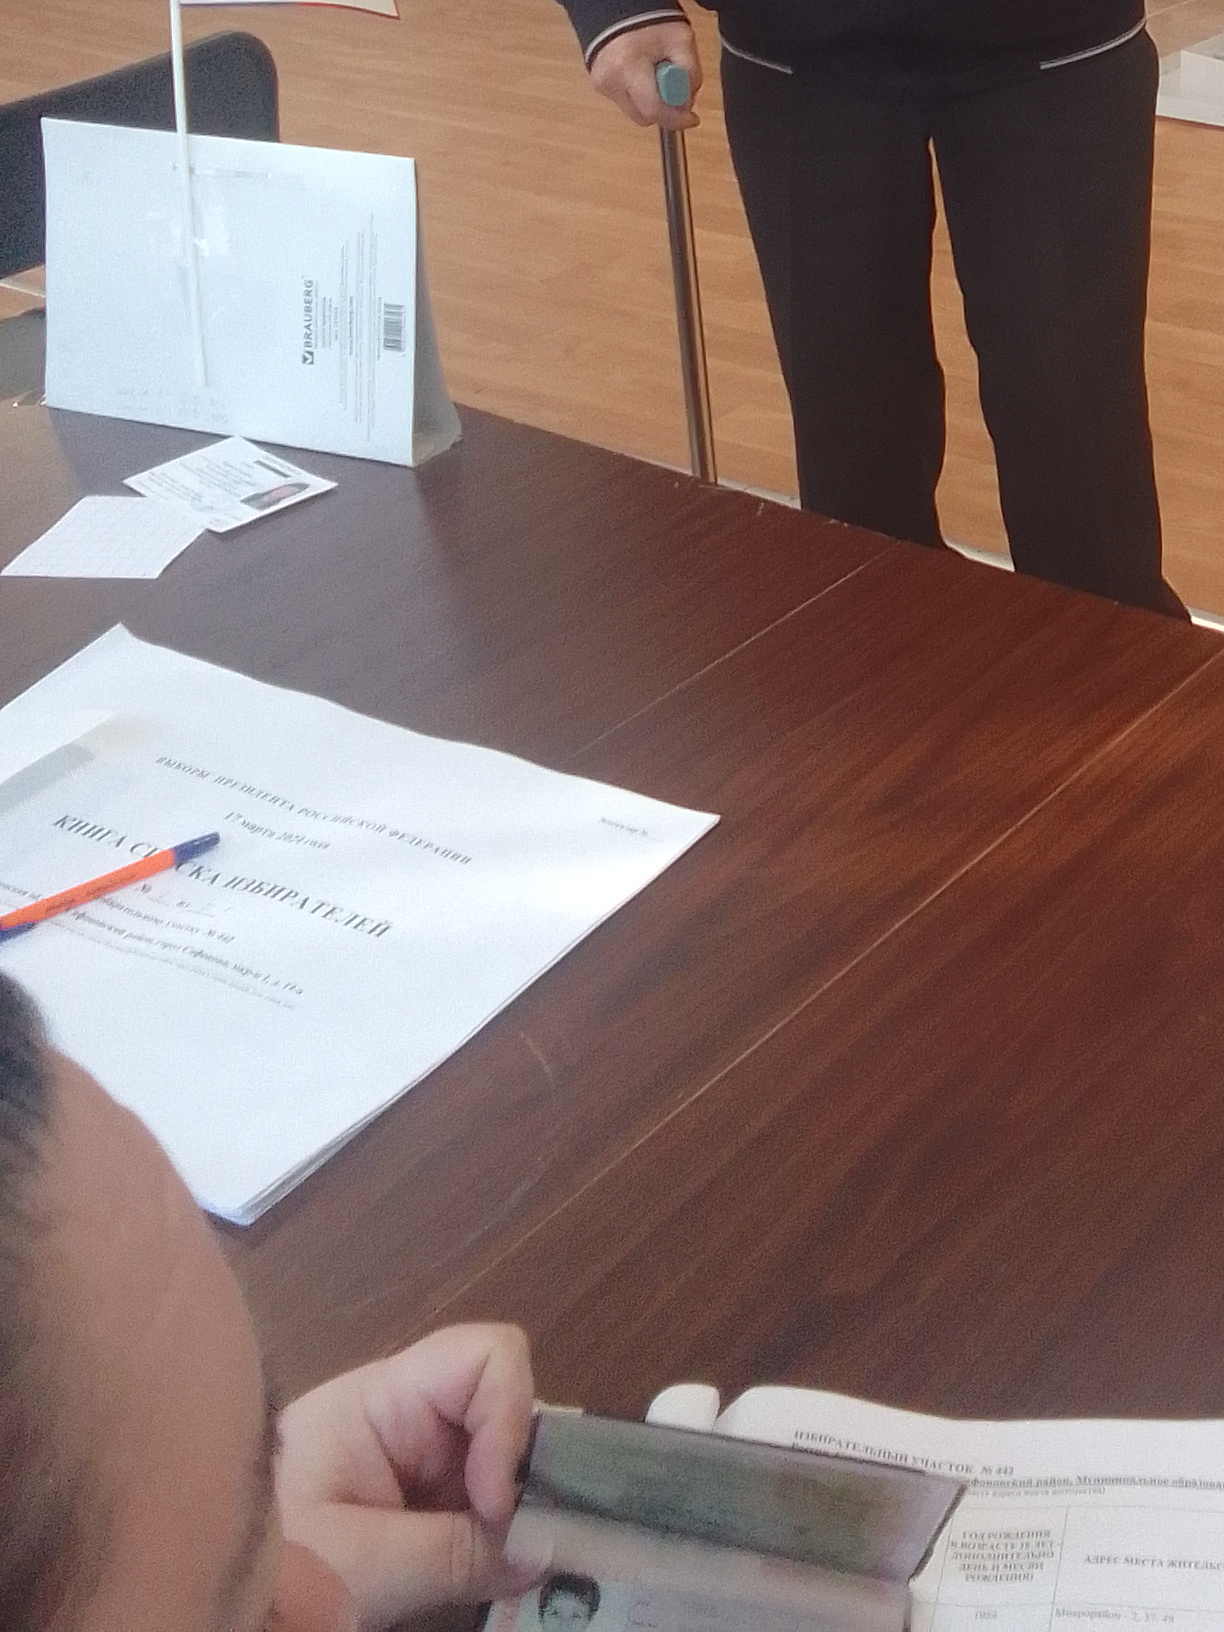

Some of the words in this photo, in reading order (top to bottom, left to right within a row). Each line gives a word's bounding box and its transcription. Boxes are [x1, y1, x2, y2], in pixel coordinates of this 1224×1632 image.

[303, 279, 314, 349] BRAUBERG
[53, 814, 128, 848] КНИГА
[130, 842, 222, 885] СПСКА
[222, 875, 393, 939] ИЗБИРАТЕЛЕЙ
[794, 1430, 908, 1463] ИЗБИРАТЕЛЬНЫЙ
[1084, 1554, 1121, 1566] АДРЕС
[1123, 1556, 1165, 1569] МЕСТА
